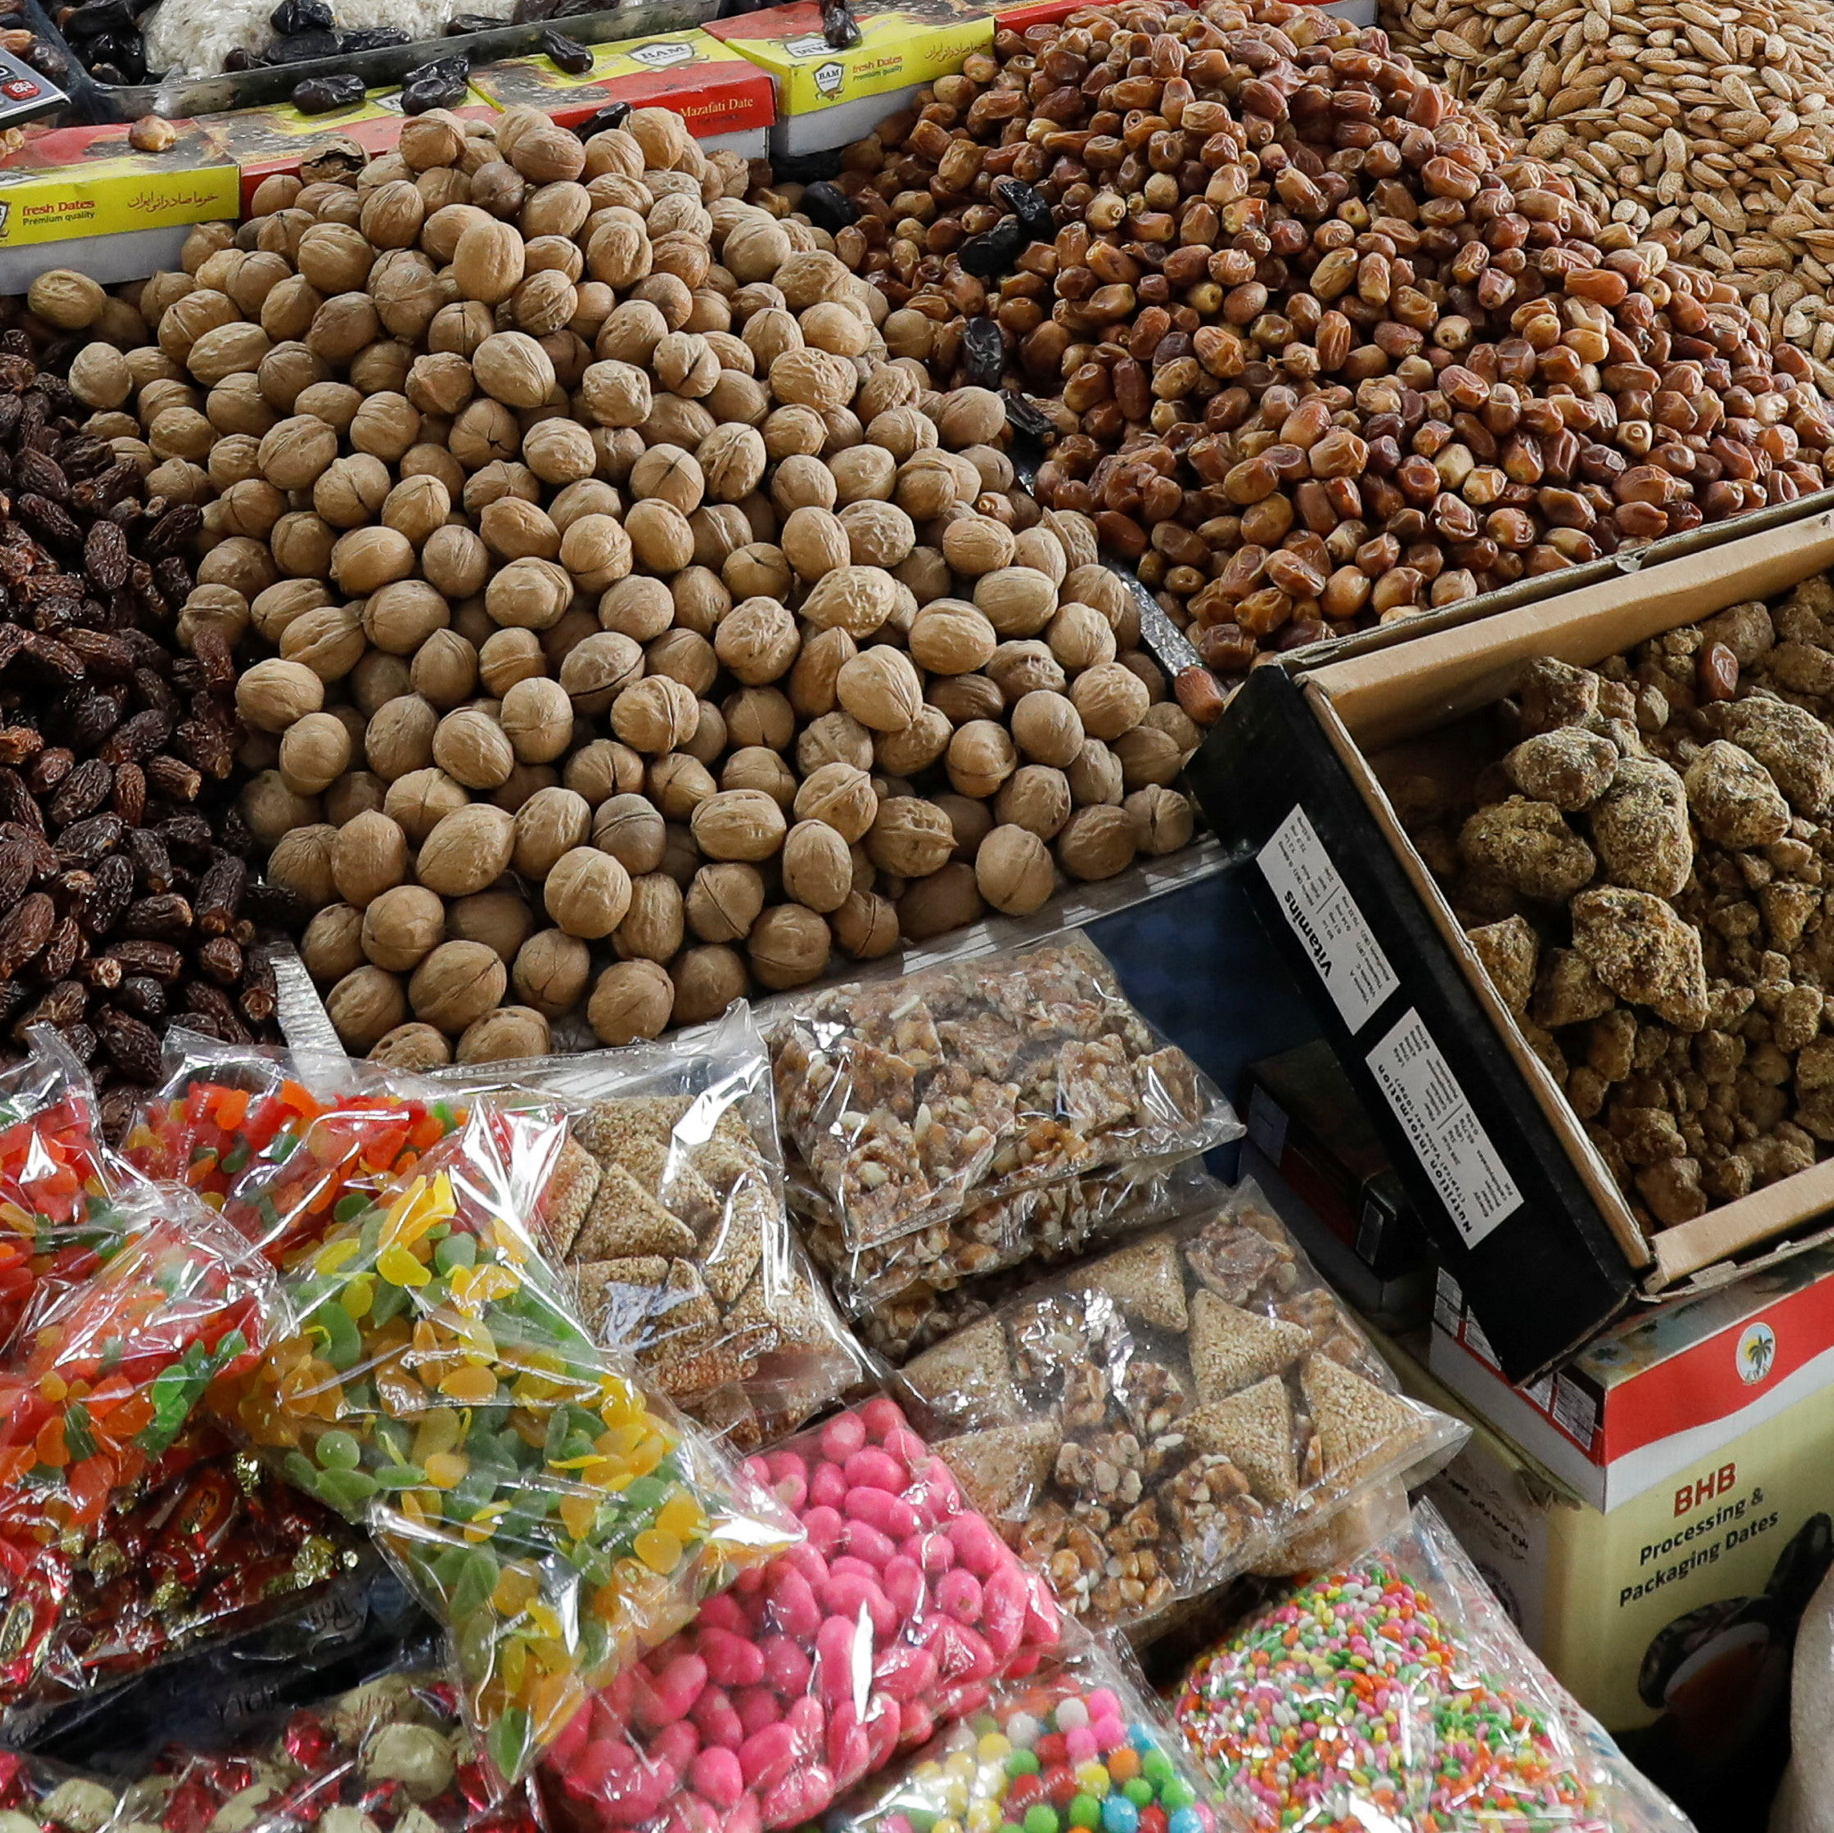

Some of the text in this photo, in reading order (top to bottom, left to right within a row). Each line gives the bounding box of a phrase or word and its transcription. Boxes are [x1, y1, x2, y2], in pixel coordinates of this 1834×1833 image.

[876, 54, 903, 68] Dates
[679, 96, 755, 119] Mazafati Date
[22, 198, 95, 217] fresh Dates
[22, 210, 96, 227] Premium quality
[1275, 887, 1337, 978] Vitamins
[1372, 1063, 1432, 1156] Information
[1424, 1158, 1474, 1233] Nutrition
[1673, 1462, 1738, 1517] BHB
[1619, 1509, 1779, 1609] Packaging Dates
[1639, 1486, 1765, 1568] Processing &
